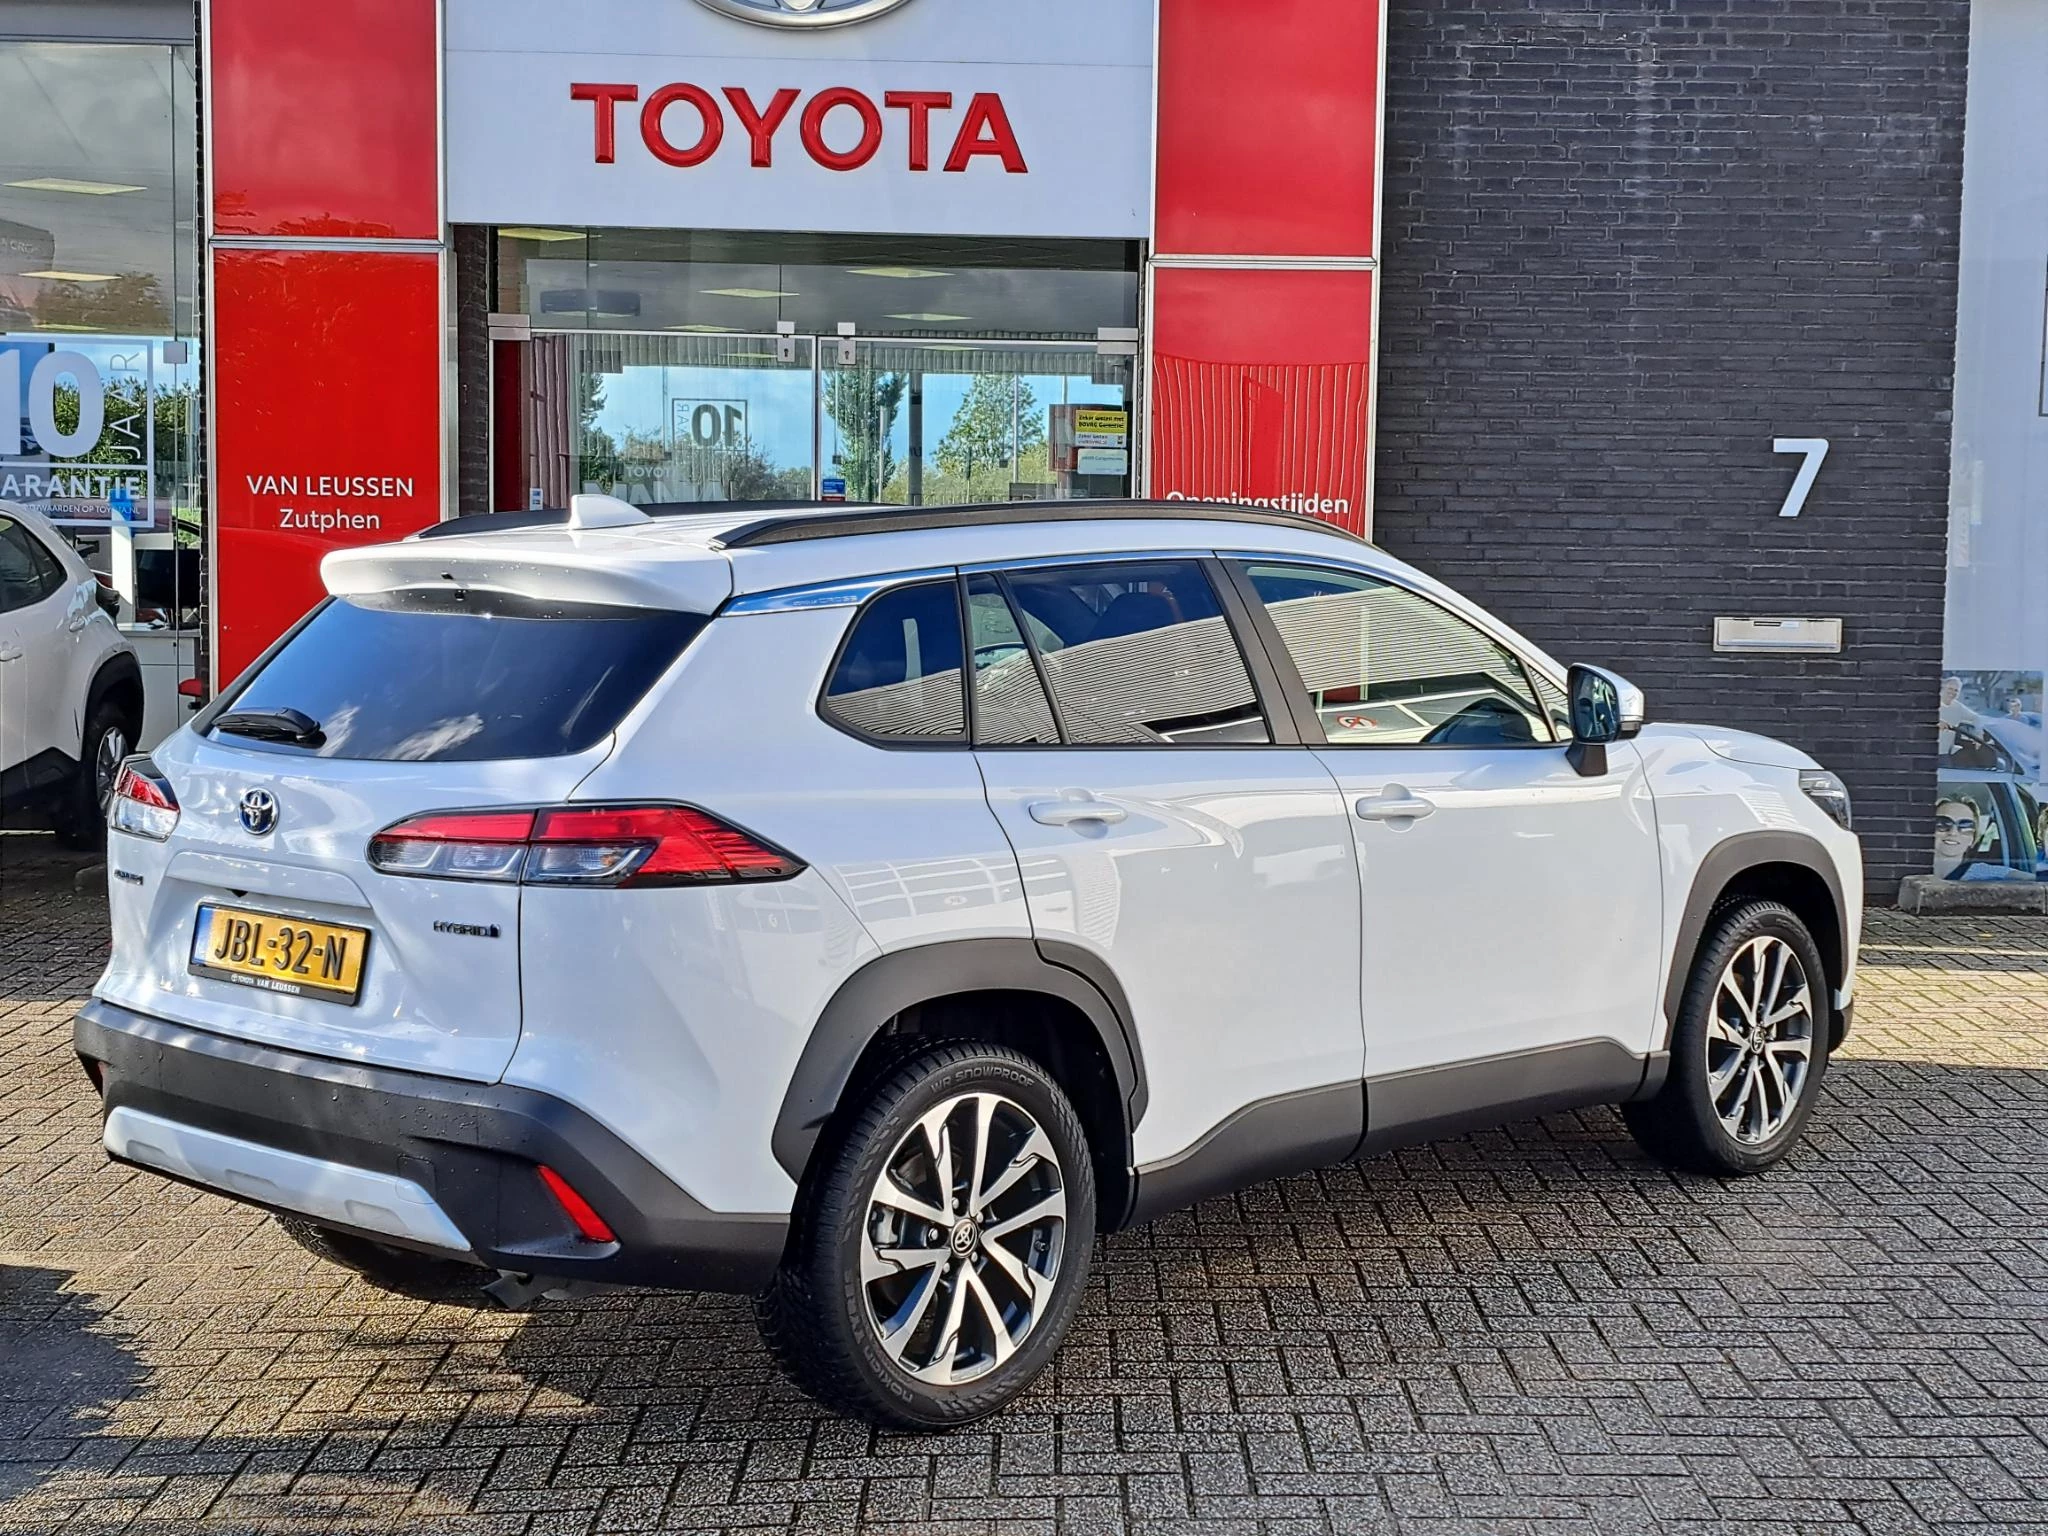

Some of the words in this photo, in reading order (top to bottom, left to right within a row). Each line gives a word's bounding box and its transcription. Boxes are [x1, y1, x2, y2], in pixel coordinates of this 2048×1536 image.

[571, 82, 1029, 174] TOYOTA
[0, 349, 104, 458] 10
[109, 352, 141, 459] JAAR
[626, 466, 677, 478] TOYOT
[1773, 437, 1829, 518] 7
[246, 475, 298, 495] VAN
[306, 476, 413, 497] LEUSSEN
[279, 508, 380, 533] Zutphen
[433, 920, 488, 937] HYBRID
[214, 918, 348, 981] JBL-32-N
[256, 977, 270, 988] VAN
[271, 980, 301, 994] LEUSSEN
[955, 1066, 1036, 1088] SNOWPROOF
